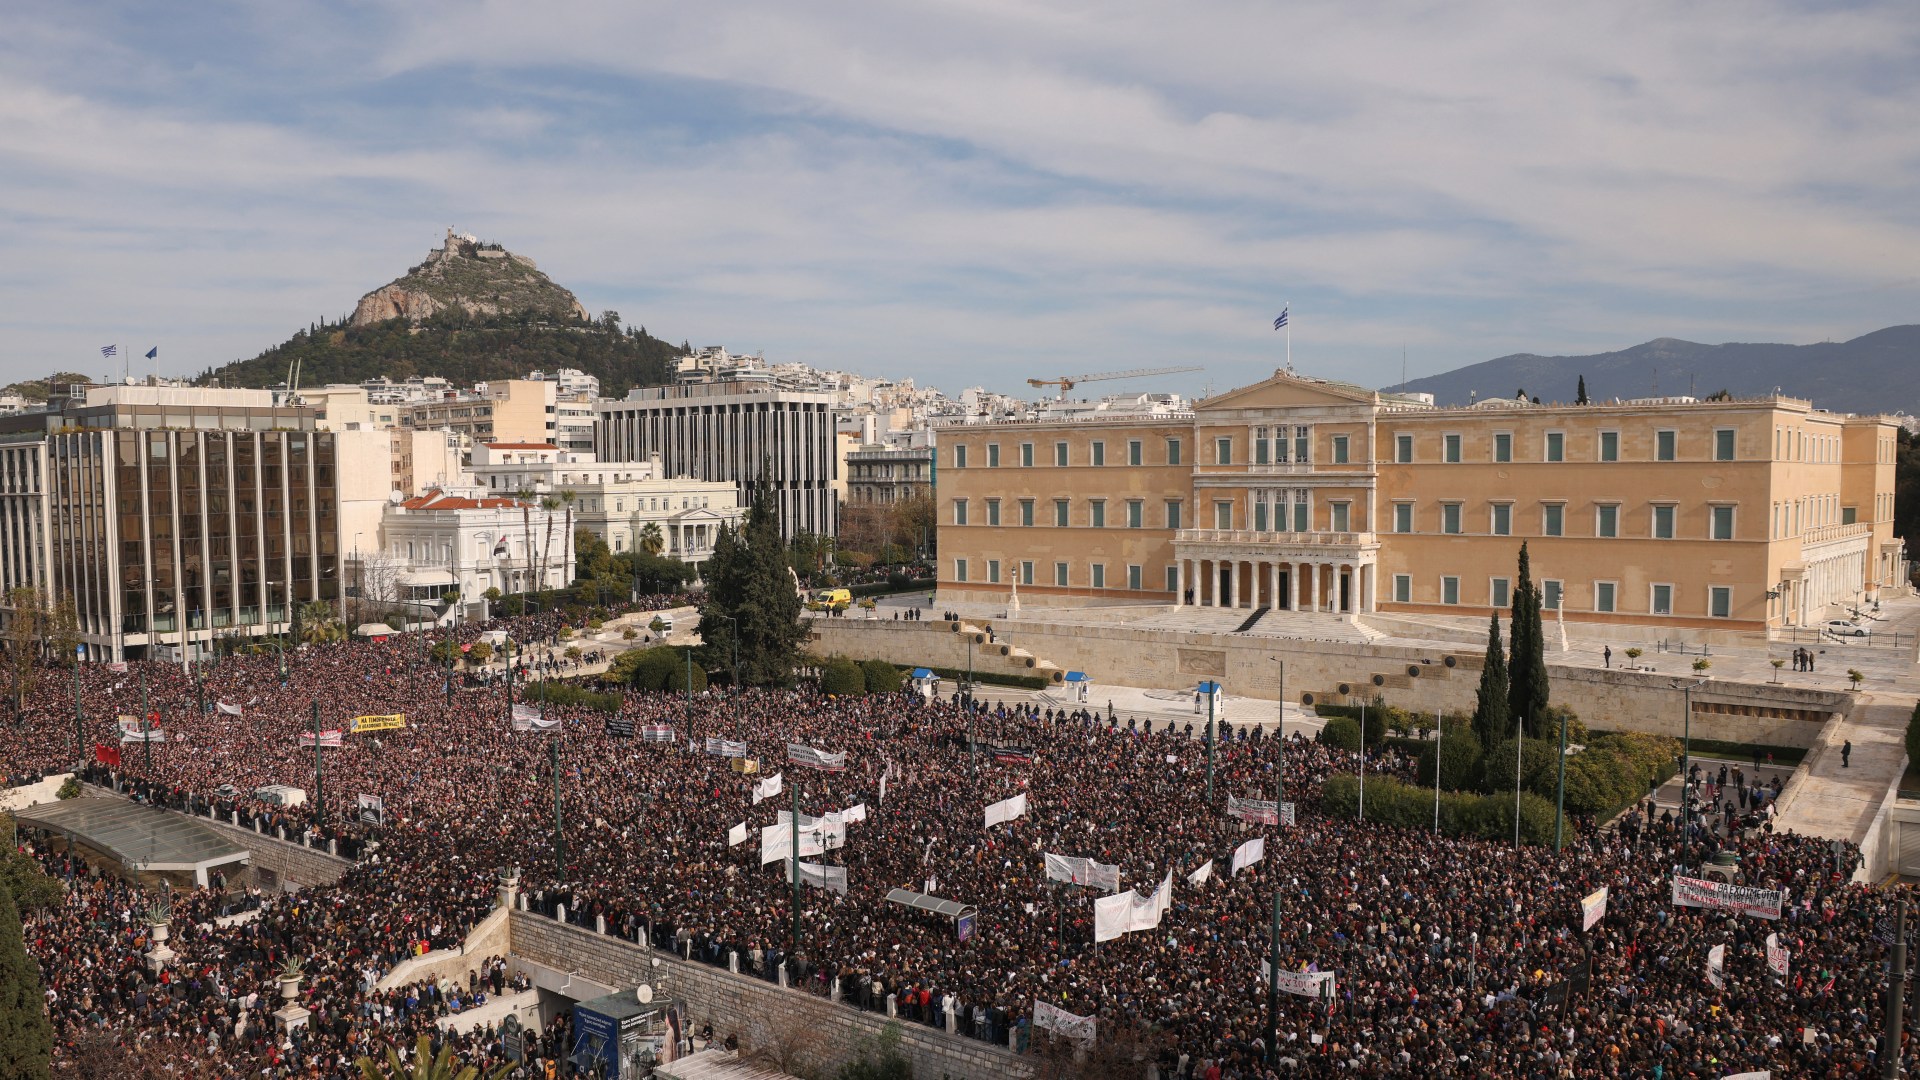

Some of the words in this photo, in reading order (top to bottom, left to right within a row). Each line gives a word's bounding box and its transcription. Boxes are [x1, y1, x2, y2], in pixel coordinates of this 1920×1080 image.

[1677, 877, 1716, 891] ΟΞΥΓΟΝΟ
[1718, 883, 1729, 894] ΘΑ
[1730, 885, 1762, 899] ΕΧΟΥΜΕ
[1762, 890, 1780, 901] ΟΤΑΝ
